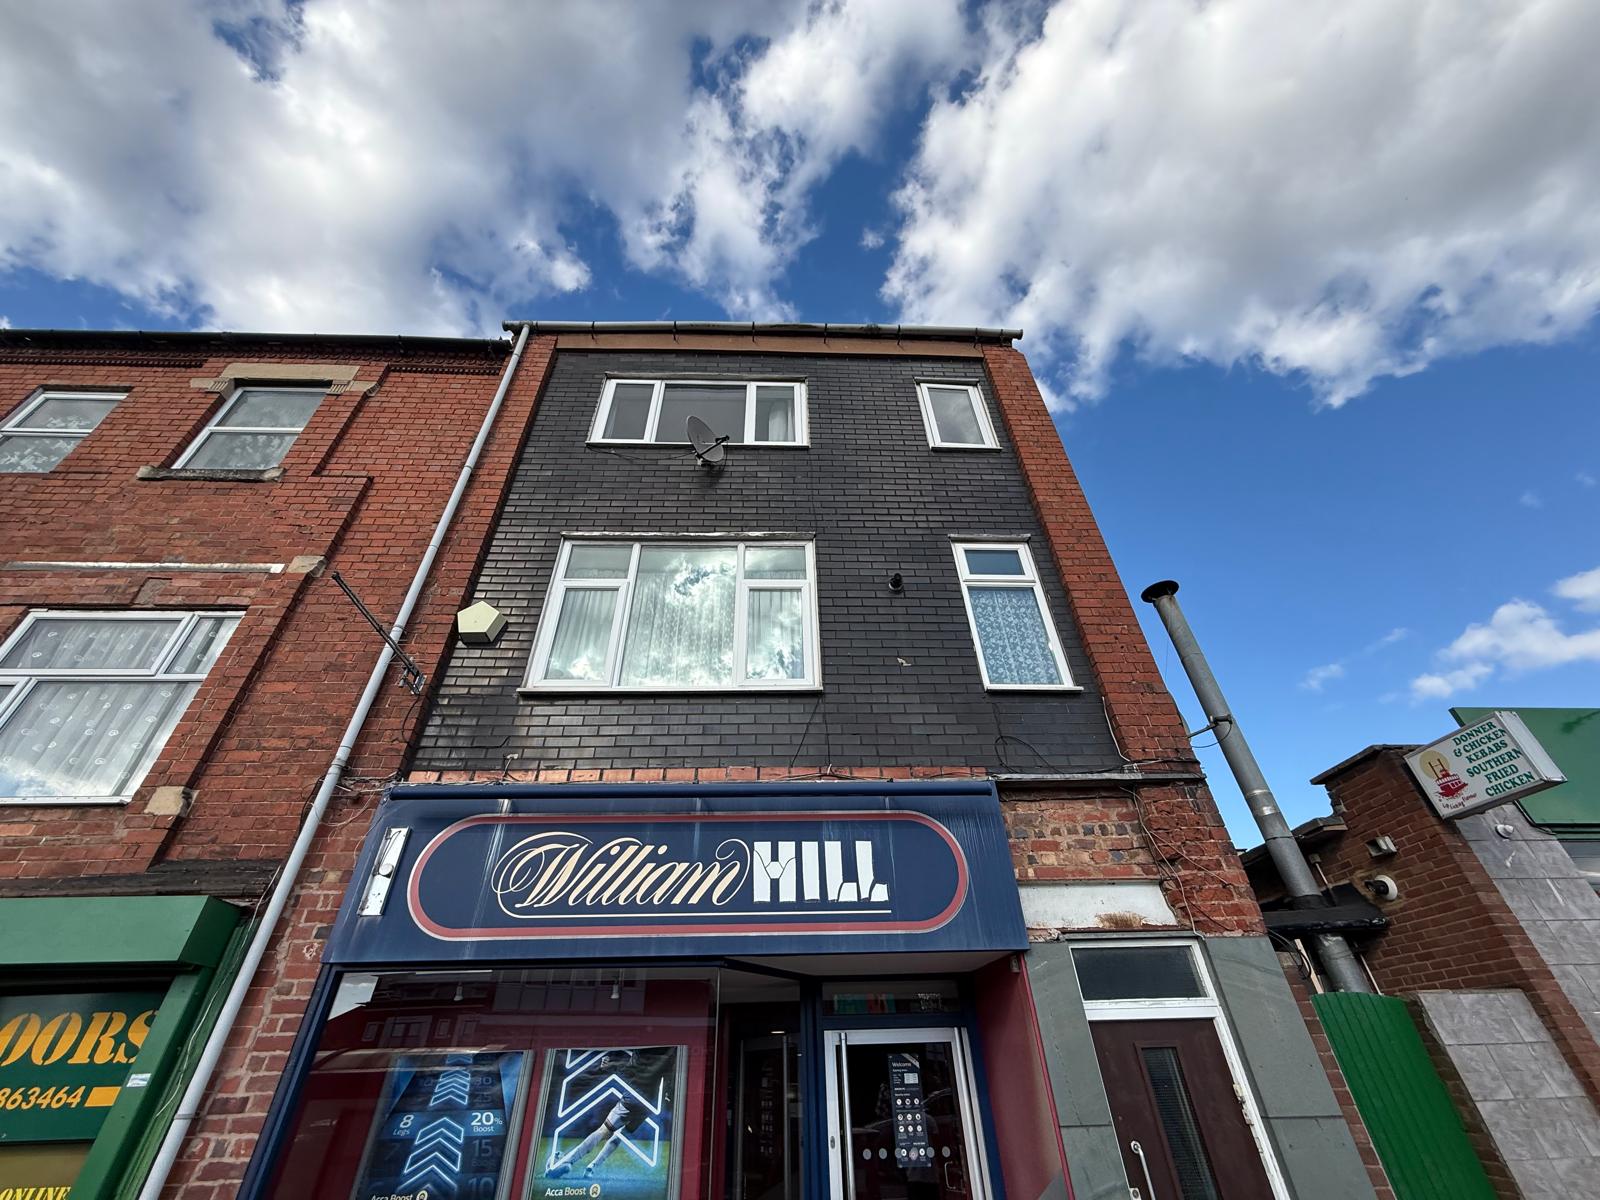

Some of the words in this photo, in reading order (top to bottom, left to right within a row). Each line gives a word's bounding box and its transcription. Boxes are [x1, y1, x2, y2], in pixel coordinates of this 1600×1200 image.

[1452, 721, 1497, 746] DONNER
[1453, 748, 1463, 757] &
[1463, 728, 1507, 753] CHICKEN
[1465, 740, 1508, 763] KEBABS
[1466, 746, 1523, 777] SOUTHERN
[1485, 764, 1519, 784] FRIED
[1485, 771, 1536, 796] CHICKEN
[492, 831, 750, 911] William
[753, 841, 889, 904] HILL
[392, 1128, 410, 1136] Legs
[399, 1114, 414, 1128] 8
[545, 1187, 563, 1196] Acca
[564, 1186, 586, 1196] Boost
